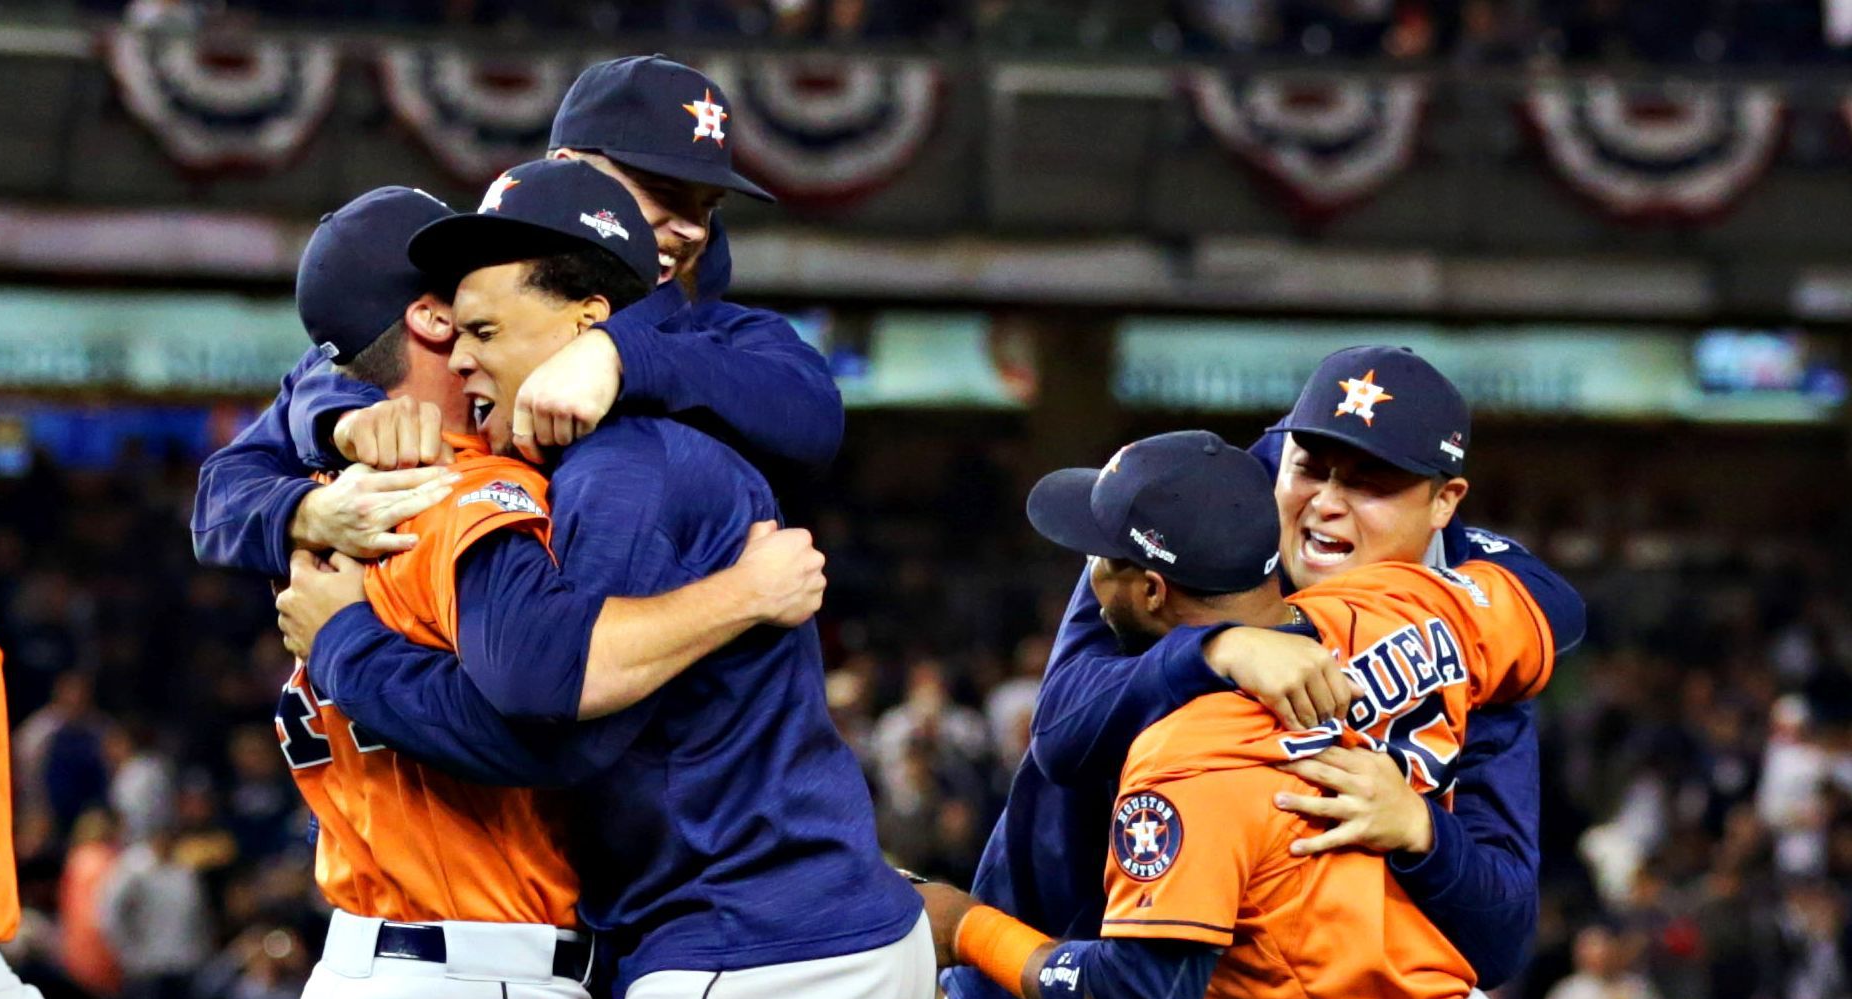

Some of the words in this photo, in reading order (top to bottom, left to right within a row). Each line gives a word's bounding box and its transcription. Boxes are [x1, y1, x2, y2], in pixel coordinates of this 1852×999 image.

[693, 100, 725, 139] H
[1337, 378, 1385, 419] H
[1117, 796, 1173, 824] HOUSTON
[1132, 821, 1159, 854] H
[1123, 854, 1170, 876] ASTROS
